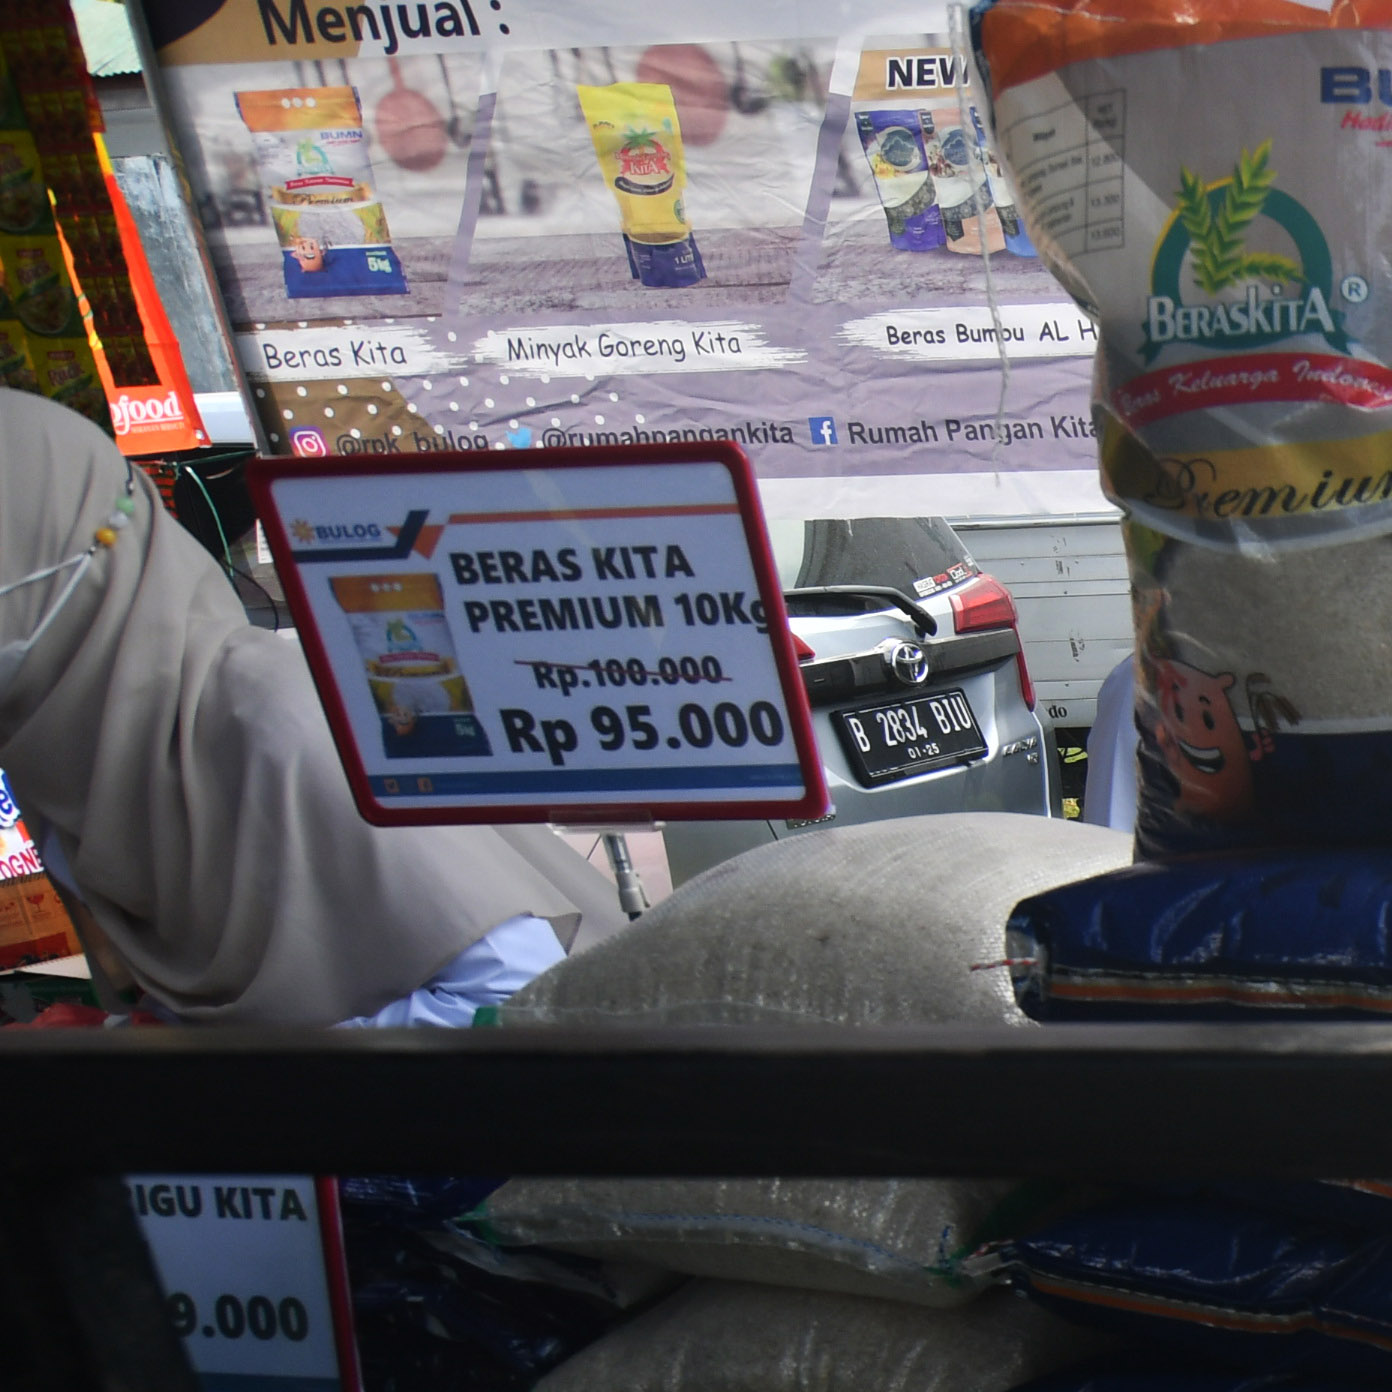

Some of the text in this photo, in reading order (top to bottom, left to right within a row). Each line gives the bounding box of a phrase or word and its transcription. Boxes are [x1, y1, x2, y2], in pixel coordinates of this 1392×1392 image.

[257, 0, 481, 54] Menjual
[888, 58, 969, 88] NEW
[320, 131, 363, 141] BUMN
[506, 331, 742, 367] Minyak Goreng Kita
[887, 325, 946, 346] Beras
[955, 323, 1025, 344] Bumbu
[1039, 320, 1069, 341] AL
[262, 340, 408, 370] Beras Kita
[1168, 366, 1280, 394] Keluarga
[848, 416, 1098, 446] Rumah Pangan Kita
[314, 524, 382, 540] BULOG
[448, 544, 695, 586] BERAS KITA
[463, 591, 770, 634] PREMIUM 10Kg
[531, 655, 724, 697] Rp.100.000
[499, 700, 785, 767] Rp 95.000
[849, 695, 972, 753] B 2834 BIU
[216, 1185, 308, 1223] KITA
